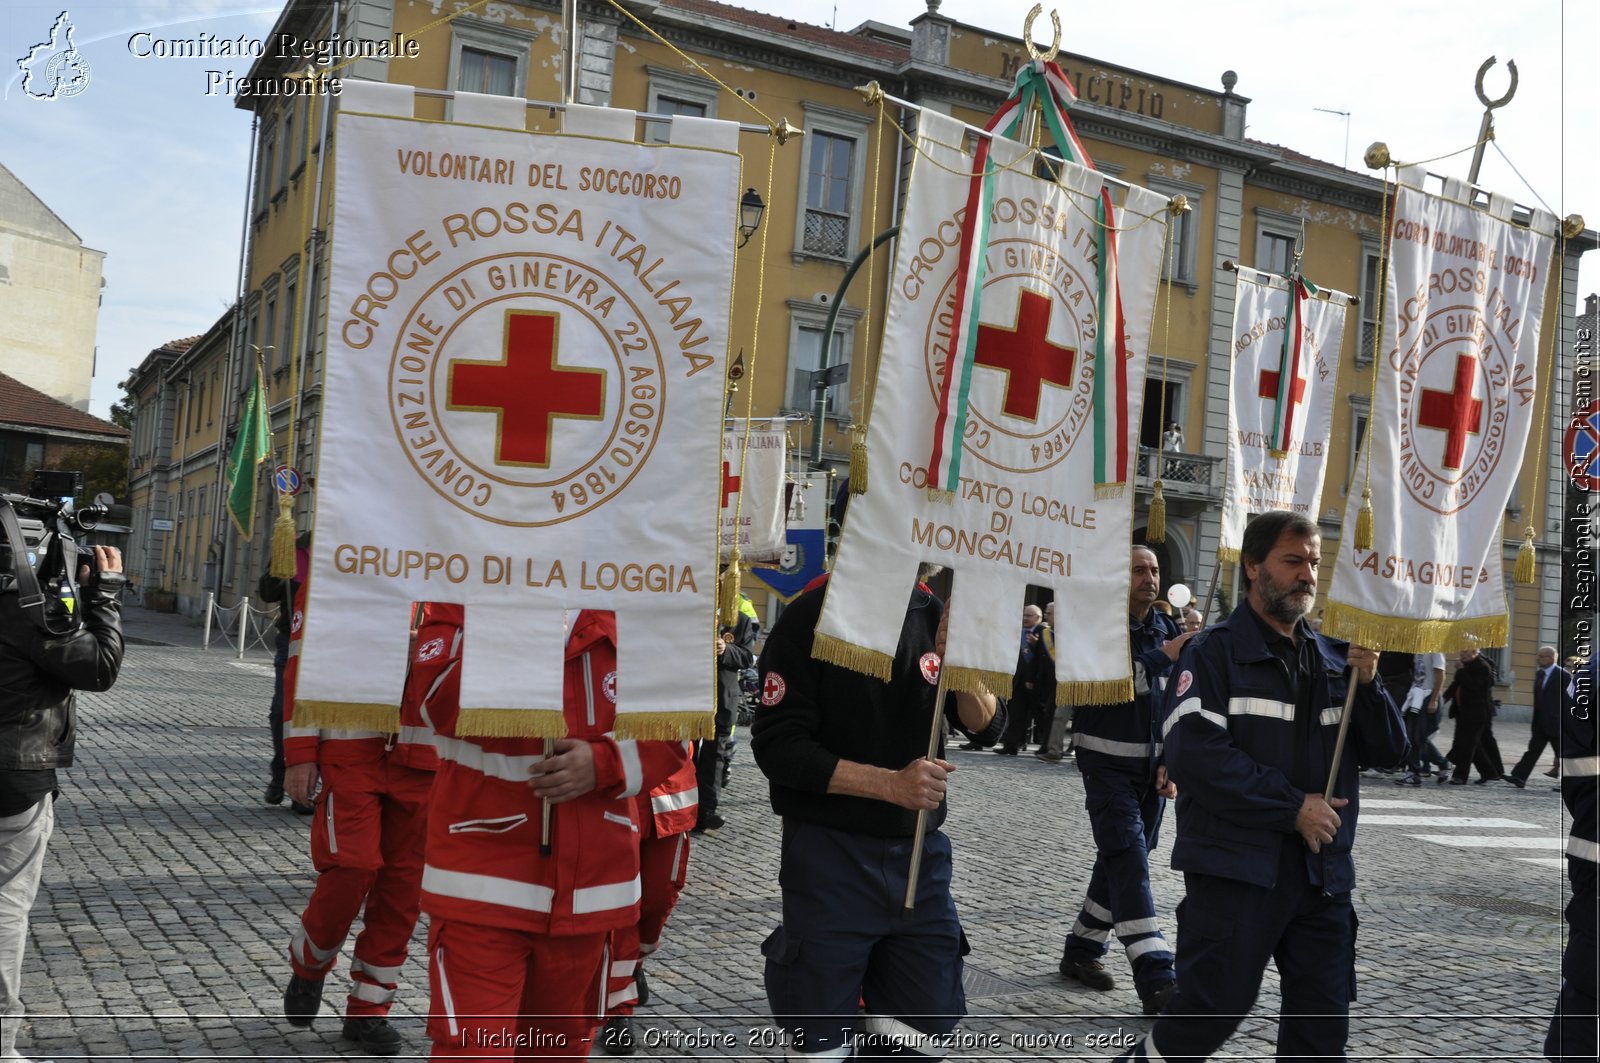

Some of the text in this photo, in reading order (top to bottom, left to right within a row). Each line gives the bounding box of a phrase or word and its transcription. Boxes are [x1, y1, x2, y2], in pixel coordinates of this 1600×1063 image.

[1000, 52, 1164, 119] MICIPIO
[398, 149, 682, 200] VOLONTARI DEL SOCCORSO
[342, 202, 714, 377] CROCE ROSSA ITALIANA
[398, 261, 658, 514] CONVENZIONE DI GINEVRA 22 AGOSTO 1864
[900, 461, 1097, 530] COTATO LOCALE
[990, 511, 1013, 536] DI
[334, 543, 699, 593] GRUPPO DI LA LOGGIA
[911, 517, 1072, 577] MONCALIERI
